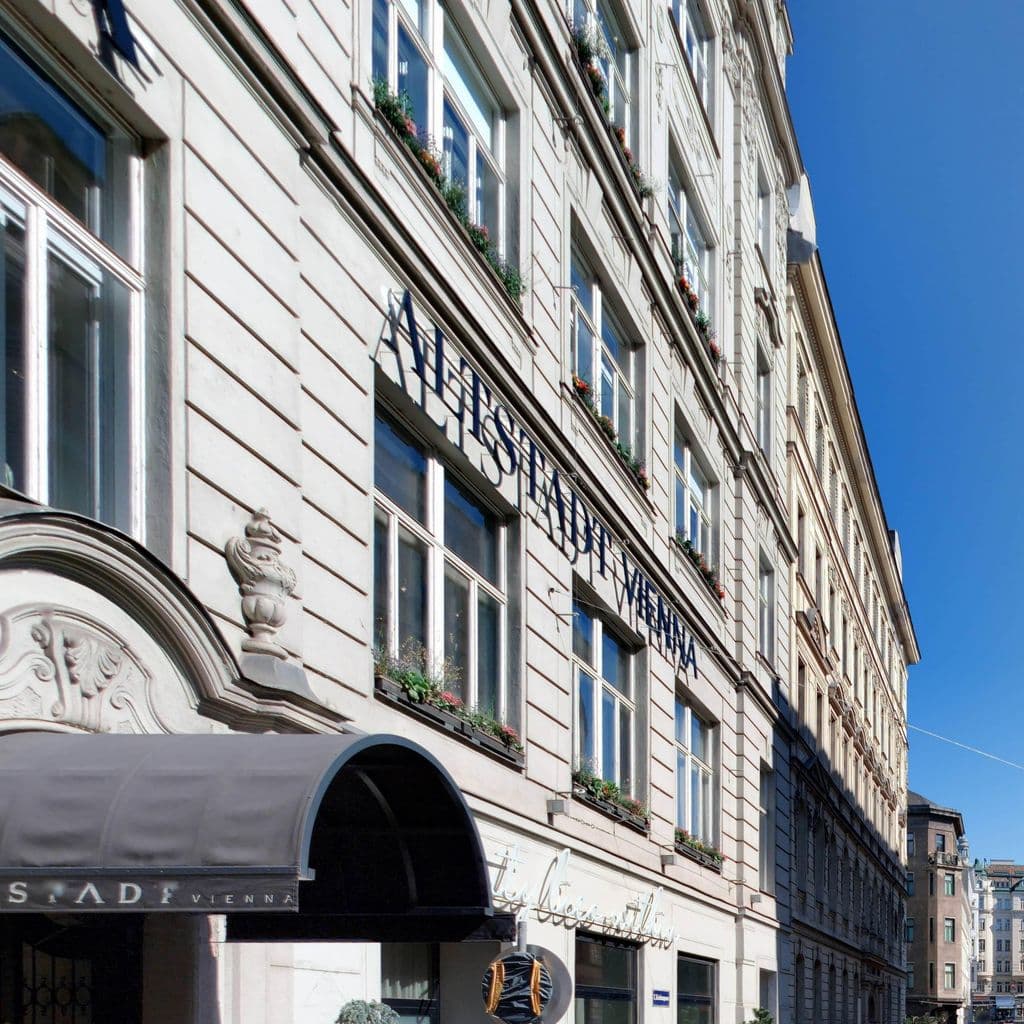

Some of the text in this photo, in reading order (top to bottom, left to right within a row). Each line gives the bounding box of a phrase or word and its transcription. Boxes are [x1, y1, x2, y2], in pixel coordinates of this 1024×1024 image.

[382, 288, 699, 680] ALTSTADT VIENNA
[192, 893, 294, 904] VIENNA
